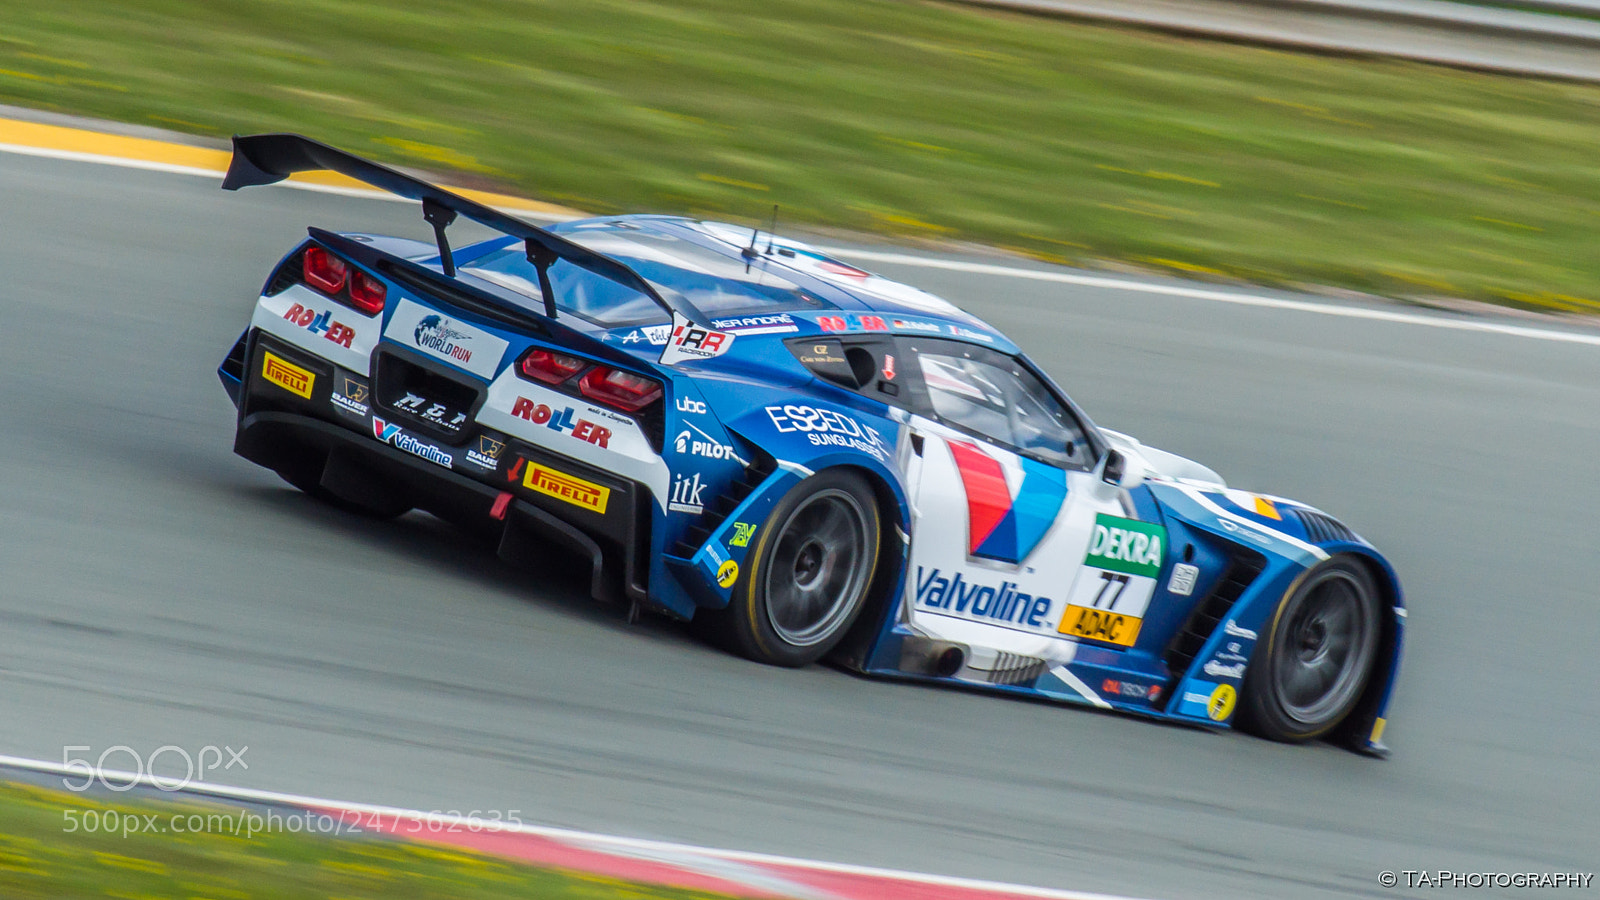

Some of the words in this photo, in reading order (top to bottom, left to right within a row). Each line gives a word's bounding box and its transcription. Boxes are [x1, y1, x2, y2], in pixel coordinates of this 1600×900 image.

[283, 302, 356, 349] ROLLER
[683, 328, 726, 352] RR
[678, 347, 717, 358] RACEROOM
[266, 358, 309, 394] PIRELLI
[332, 391, 369, 411] BAUER
[392, 400, 418, 414] Race
[420, 411, 462, 432] Exhaus
[676, 395, 707, 414] ubc
[511, 396, 613, 449] ROLLER
[764, 404, 891, 458] ESSEDUE
[395, 432, 453, 467] Valvoline
[467, 449, 499, 467] BAUE
[691, 440, 735, 460] PILOT
[807, 433, 885, 462] SUNGLASSES
[530, 468, 601, 507] PIRELLI
[670, 472, 708, 506] itk
[1090, 524, 1162, 568] DEKRA
[915, 565, 1053, 627] Valvoline
[1092, 571, 1131, 610] 77
[1075, 610, 1124, 641] ADAC
